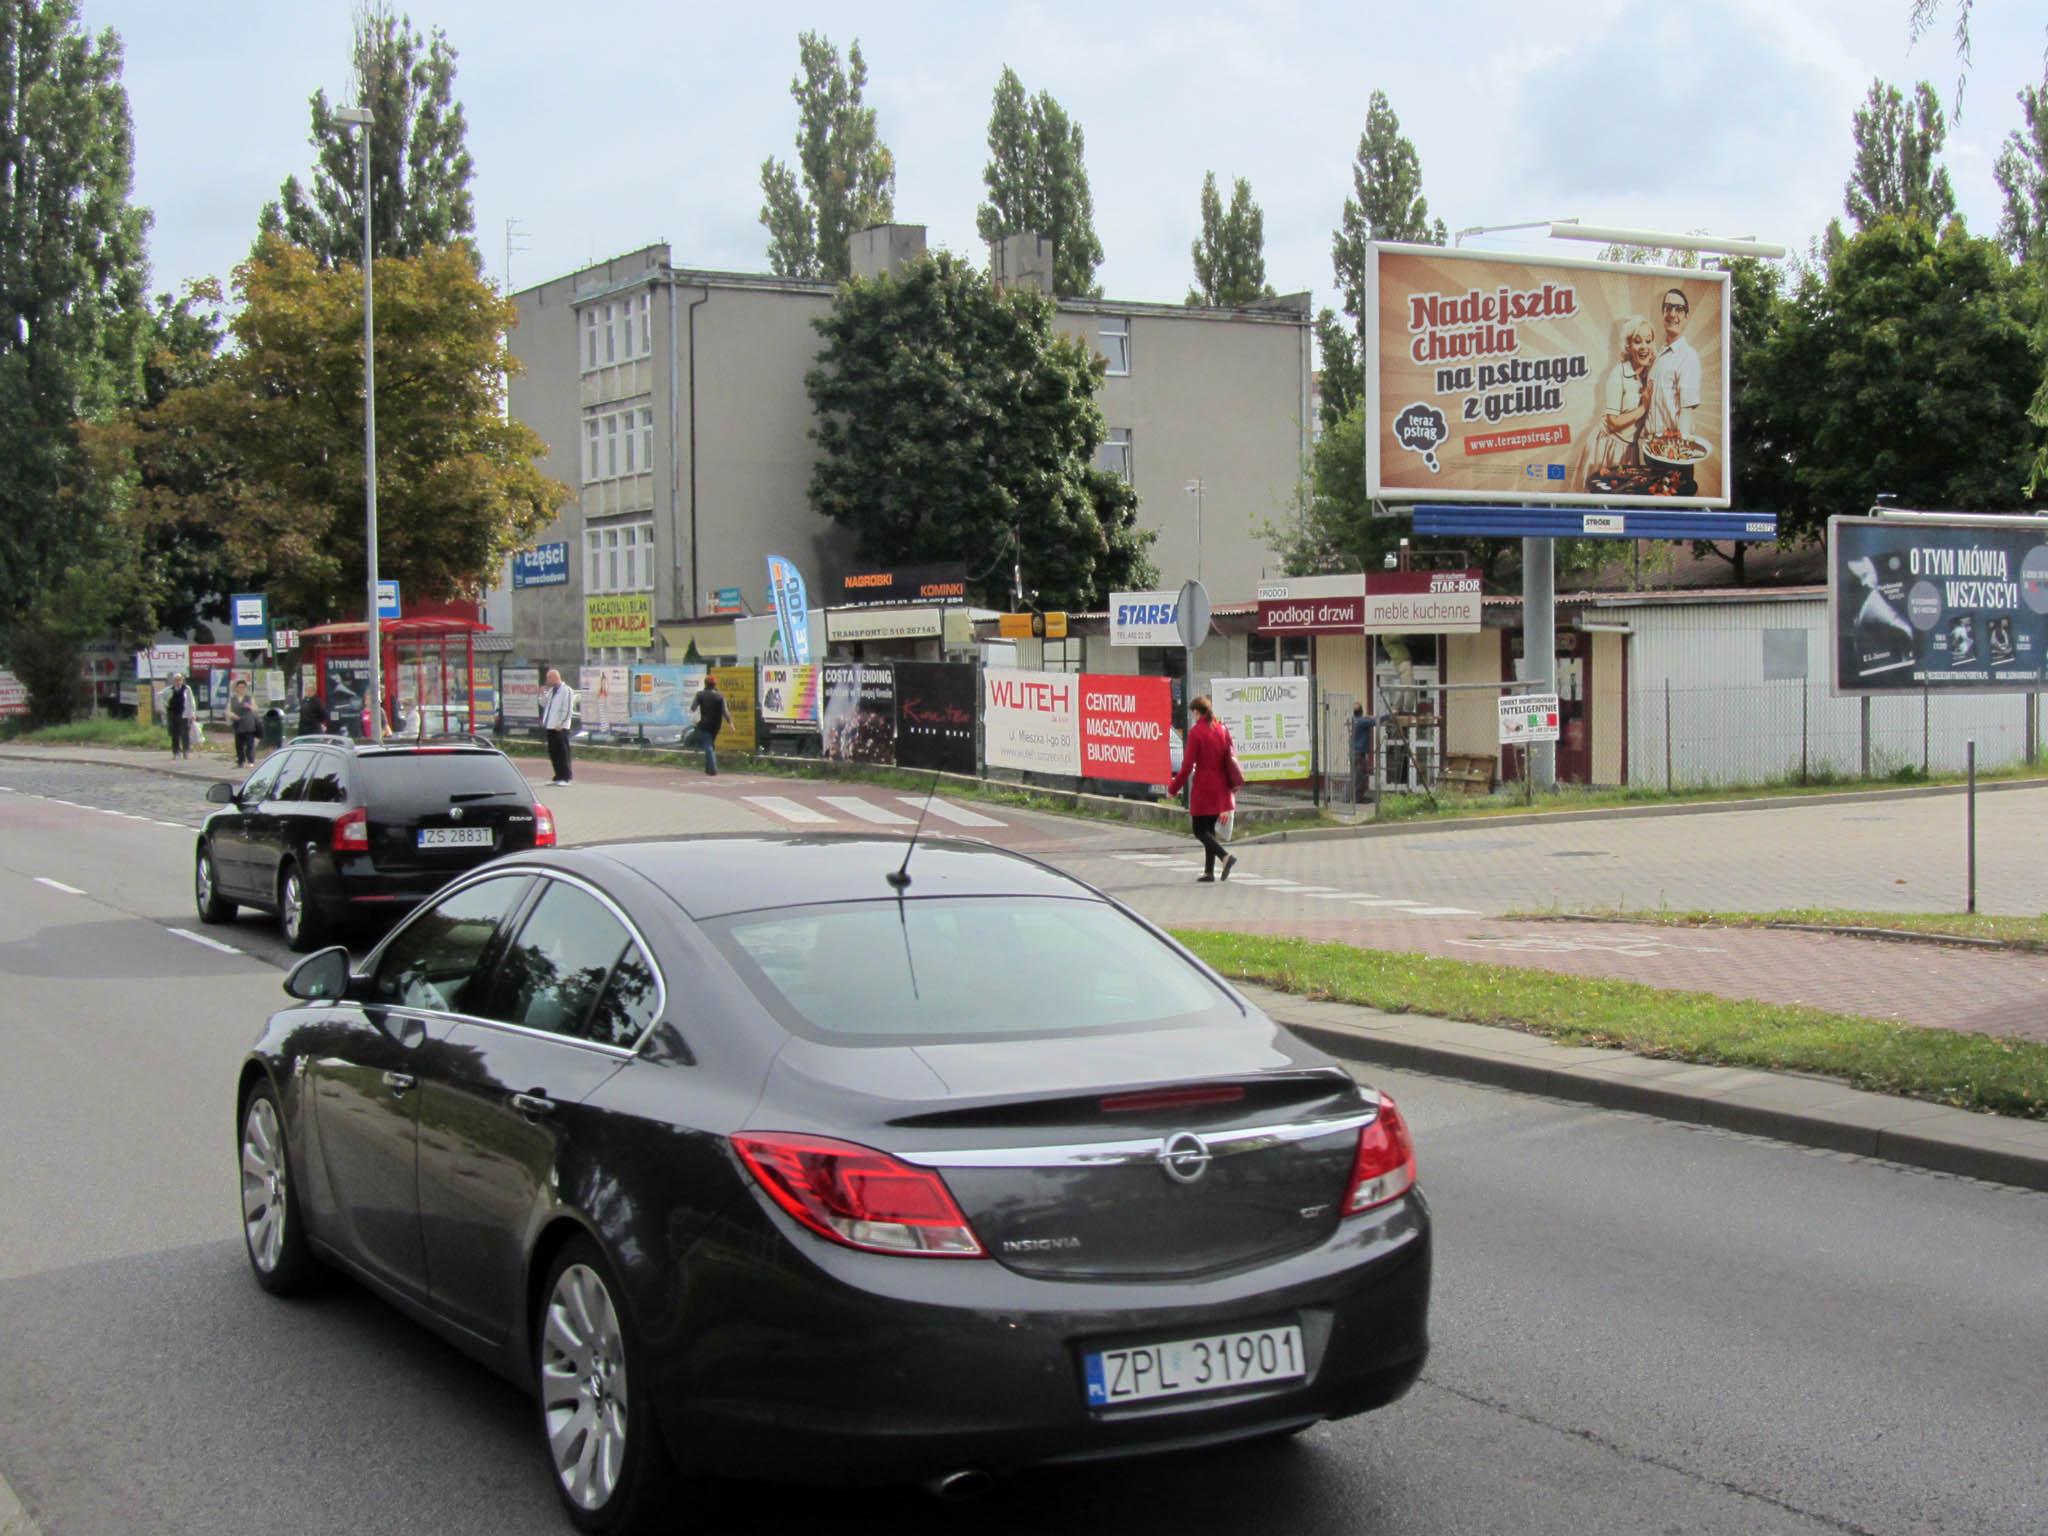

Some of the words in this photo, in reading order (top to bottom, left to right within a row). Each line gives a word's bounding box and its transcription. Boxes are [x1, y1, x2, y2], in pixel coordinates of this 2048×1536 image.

[1410, 285, 1576, 329] Nadejszła
[1412, 325, 1518, 362] chwila
[1436, 364, 1475, 392] na
[1463, 397, 1482, 420] z
[1485, 385, 1563, 422] grilla
[1409, 415, 1434, 427] teraz
[524, 544, 564, 571] części
[1910, 547, 1919, 575] O
[1923, 549, 1953, 576] TYM
[1958, 545, 2008, 581] MÓWIĄ
[844, 574, 893, 588] NAGROBKI
[920, 583, 964, 597] KOMINKI
[1945, 582, 2018, 609] WSZYSCY!
[1268, 606, 1314, 626] podłogi
[1318, 604, 1354, 622] drzwi
[1374, 602, 1409, 620] meble
[1412, 602, 1470, 619] kuchenne
[832, 629, 881, 639] TRANSPORT
[825, 670, 854, 684] COSTA
[856, 670, 892, 685] VENDING
[1086, 693, 1136, 713] CENTRUM
[1500, 704, 1557, 715] INTELIGENTNIE
[1019, 730, 1044, 744] Mieszka
[1061, 735, 1071, 747] 80
[1086, 718, 1163, 741] MAGAZYNOWO-
[1088, 743, 1136, 764] BIUROWE
[426, 830, 445, 844] ZS
[450, 829, 489, 843] 2883T
[1003, 1236, 1081, 1251] INSIGNIA
[1107, 1347, 1179, 1397] ZPL
[1193, 1331, 1296, 1384] 31901
